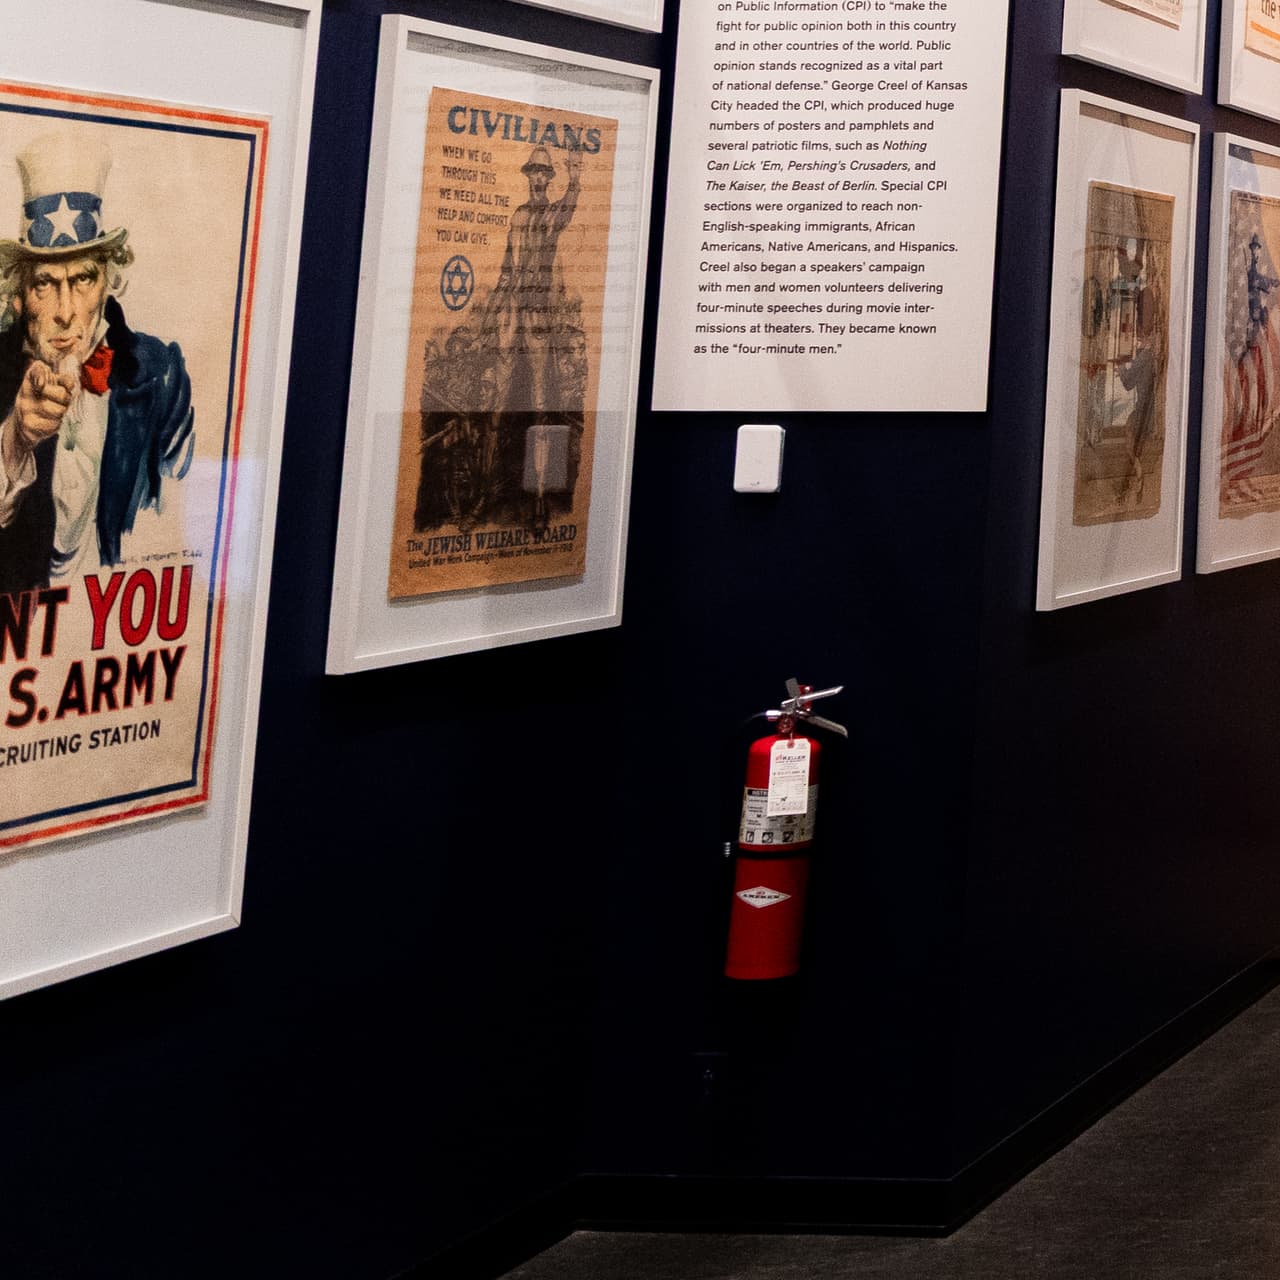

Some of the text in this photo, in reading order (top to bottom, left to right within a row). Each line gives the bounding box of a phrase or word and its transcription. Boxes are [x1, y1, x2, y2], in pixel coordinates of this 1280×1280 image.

[717, 3, 733, 12] on
[735, 0, 771, 12] Public
[773, 0, 839, 12] Information
[841, 0, 872, 12] (CPI)
[874, 0, 887, 12] to
[928, 0, 948, 11] the
[715, 19, 957, 33] fight for public opinion both in this country
[714, 39, 952, 51] and in other countries of the world. Public
[713, 59, 944, 73] opinion stands recognized as a vital part
[447, 104, 602, 156] CIVILIANS
[442, 145, 492, 164] WHEN WE GO
[442, 165, 497, 185] THROUGH THIS
[440, 188, 510, 207] WE NEED ALL THE
[438, 208, 508, 227] HELP AND COMFORT
[436, 229, 451, 242] YOU
[454, 230, 469, 243] CAN
[406, 524, 577, 556] The JEWISH WELFARE BOARD
[84, 564, 195, 651] YOU
[53, 644, 189, 721] ARMY
[88, 718, 162, 750] STATION
